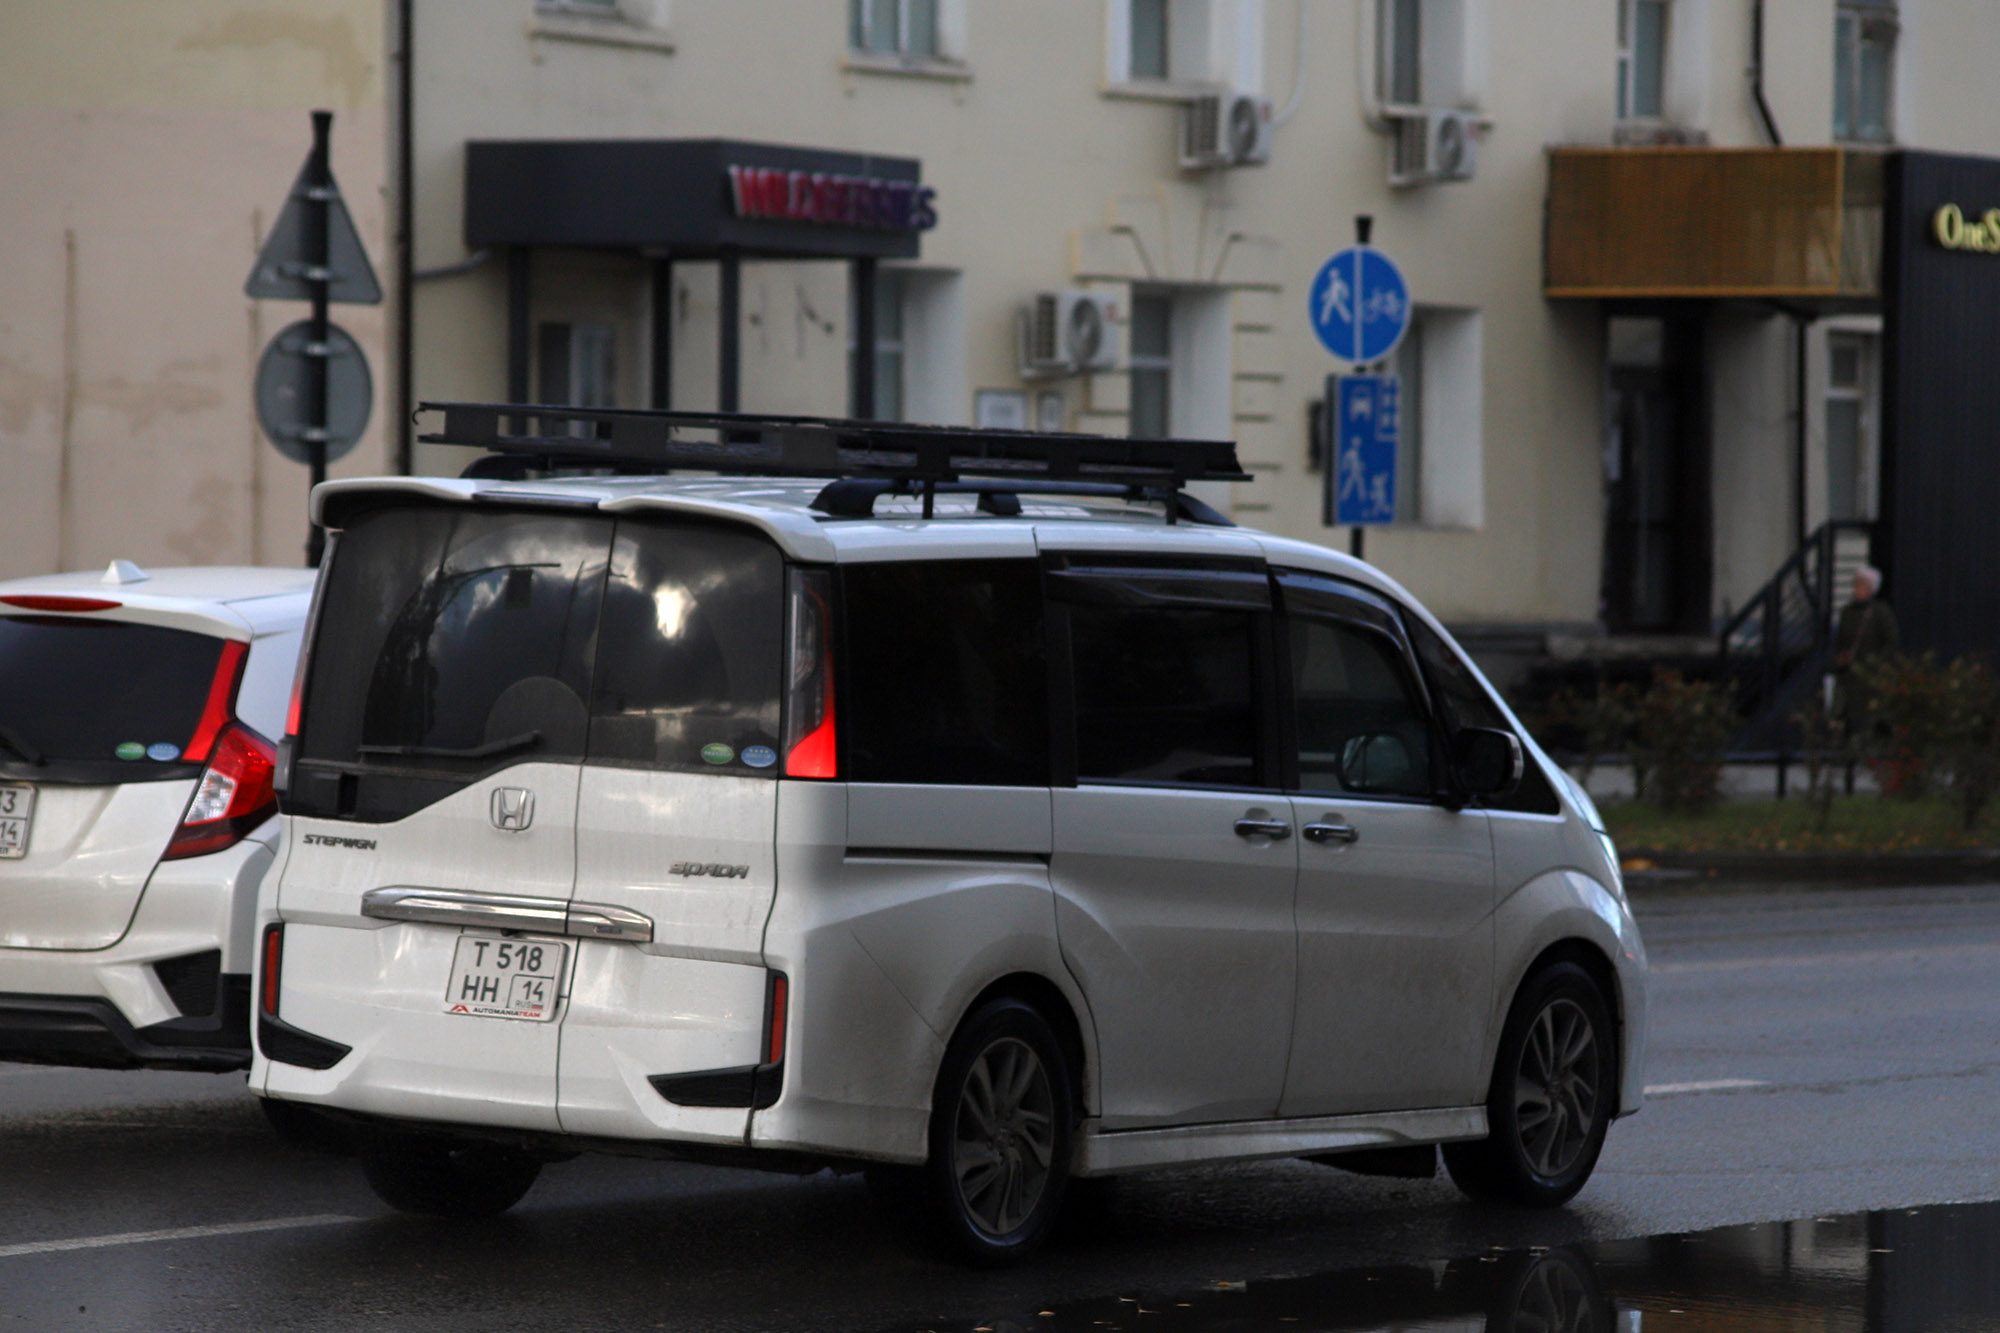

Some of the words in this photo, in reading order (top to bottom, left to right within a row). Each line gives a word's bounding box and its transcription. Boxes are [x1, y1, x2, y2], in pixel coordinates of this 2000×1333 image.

[303, 833, 377, 850] STEPWGN
[496, 943, 543, 972] 518
[523, 980, 543, 1002] 14
